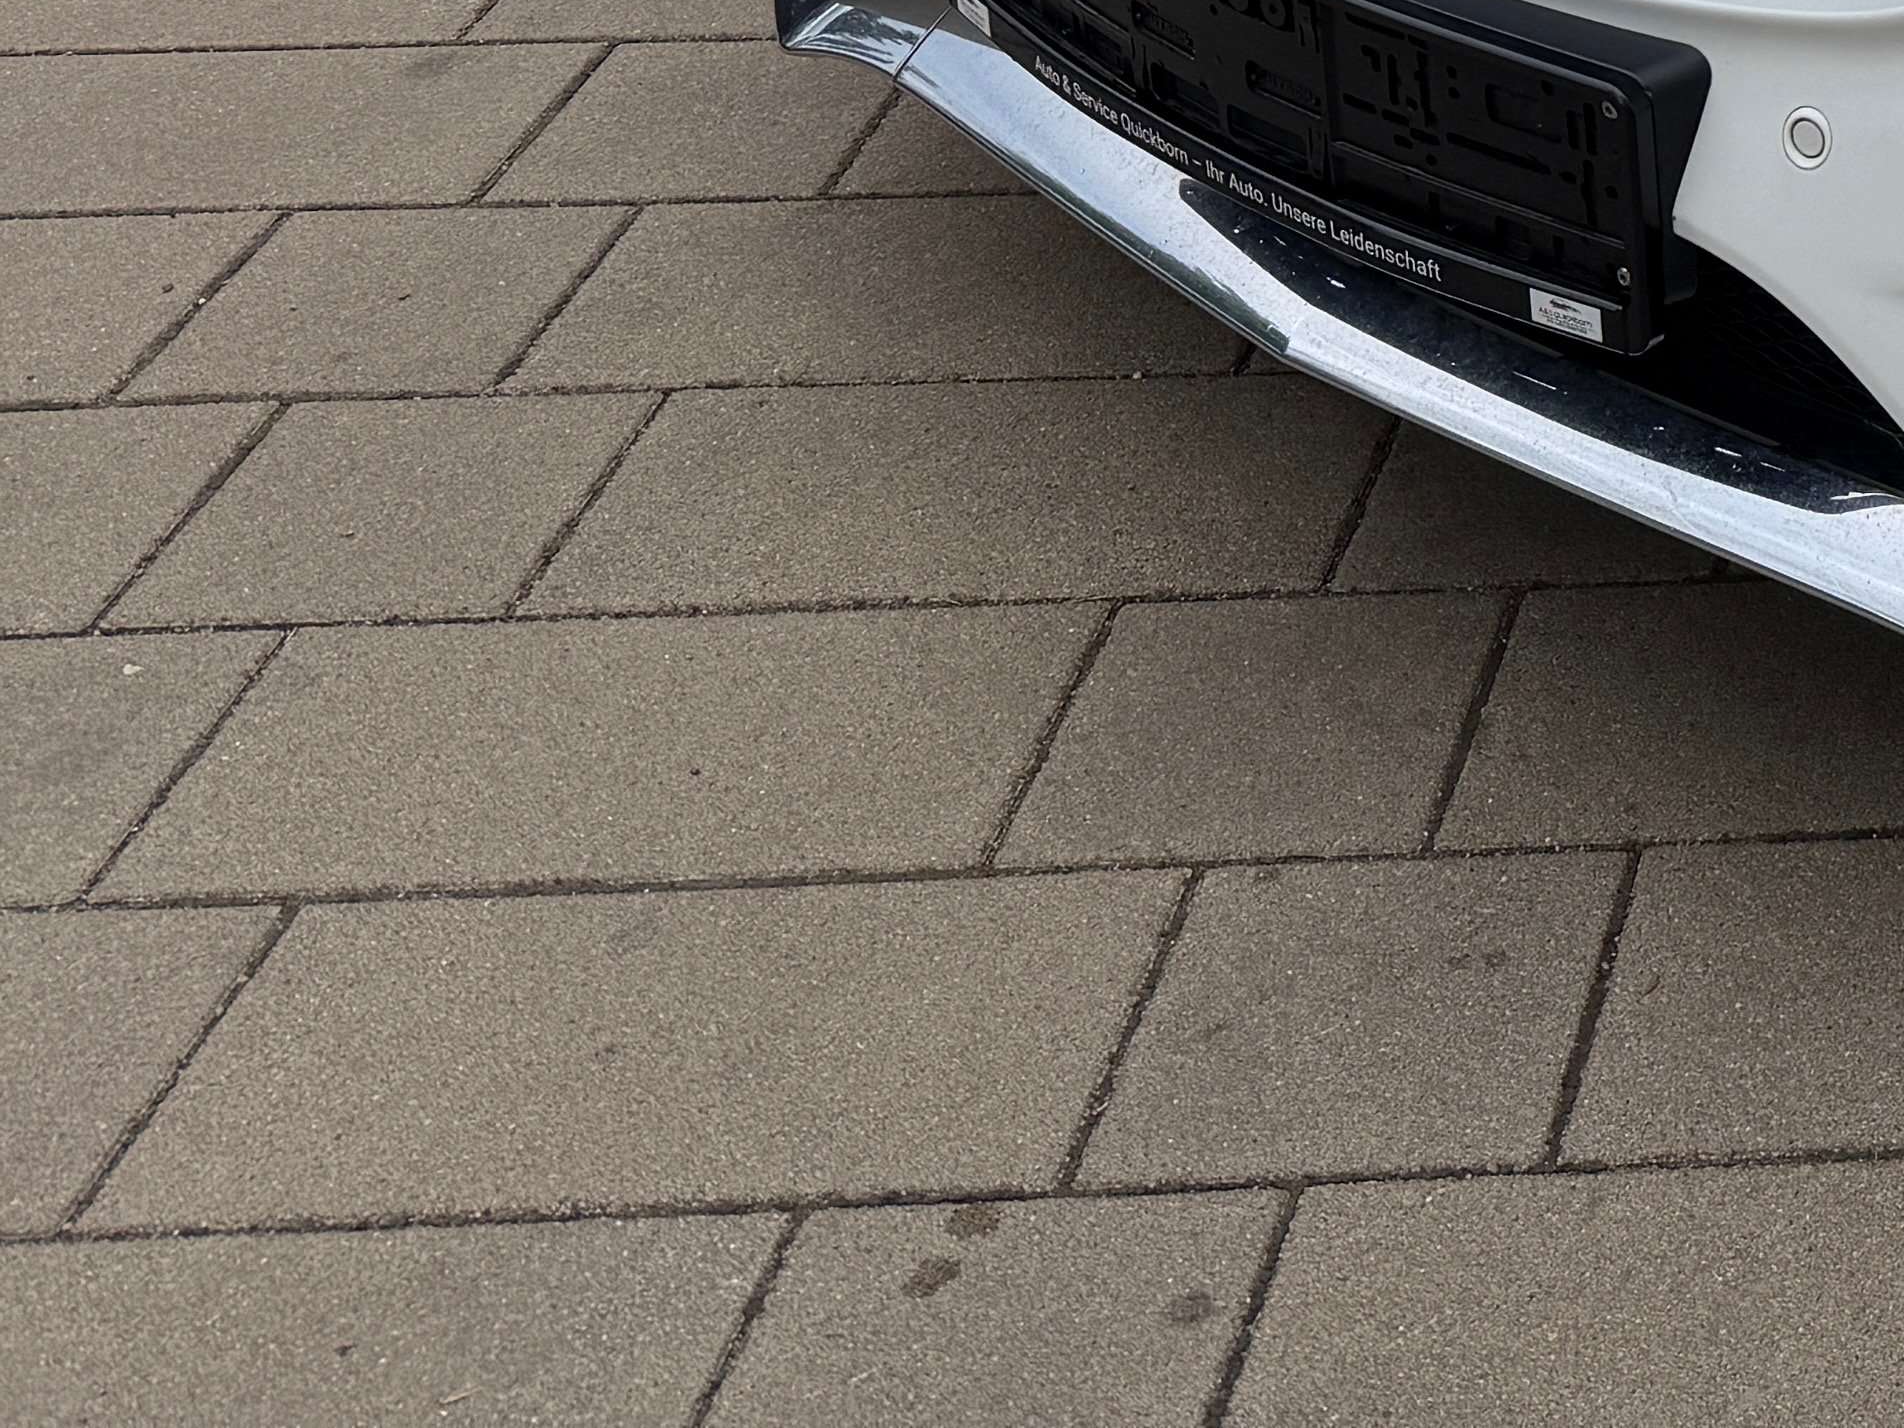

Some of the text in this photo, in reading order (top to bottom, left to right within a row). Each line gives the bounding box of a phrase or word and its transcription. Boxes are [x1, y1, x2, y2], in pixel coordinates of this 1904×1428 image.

[1035, 55, 1061, 87] Auto
[1062, 75, 1072, 94] &
[1072, 81, 1119, 126] Service
[1120, 112, 1190, 167] Quickborn
[1205, 159, 1225, 185] Ihr
[1228, 172, 1269, 207] Auto.
[1271, 192, 1327, 235] Unsere
[1329, 219, 1442, 282] Leidenschaft
